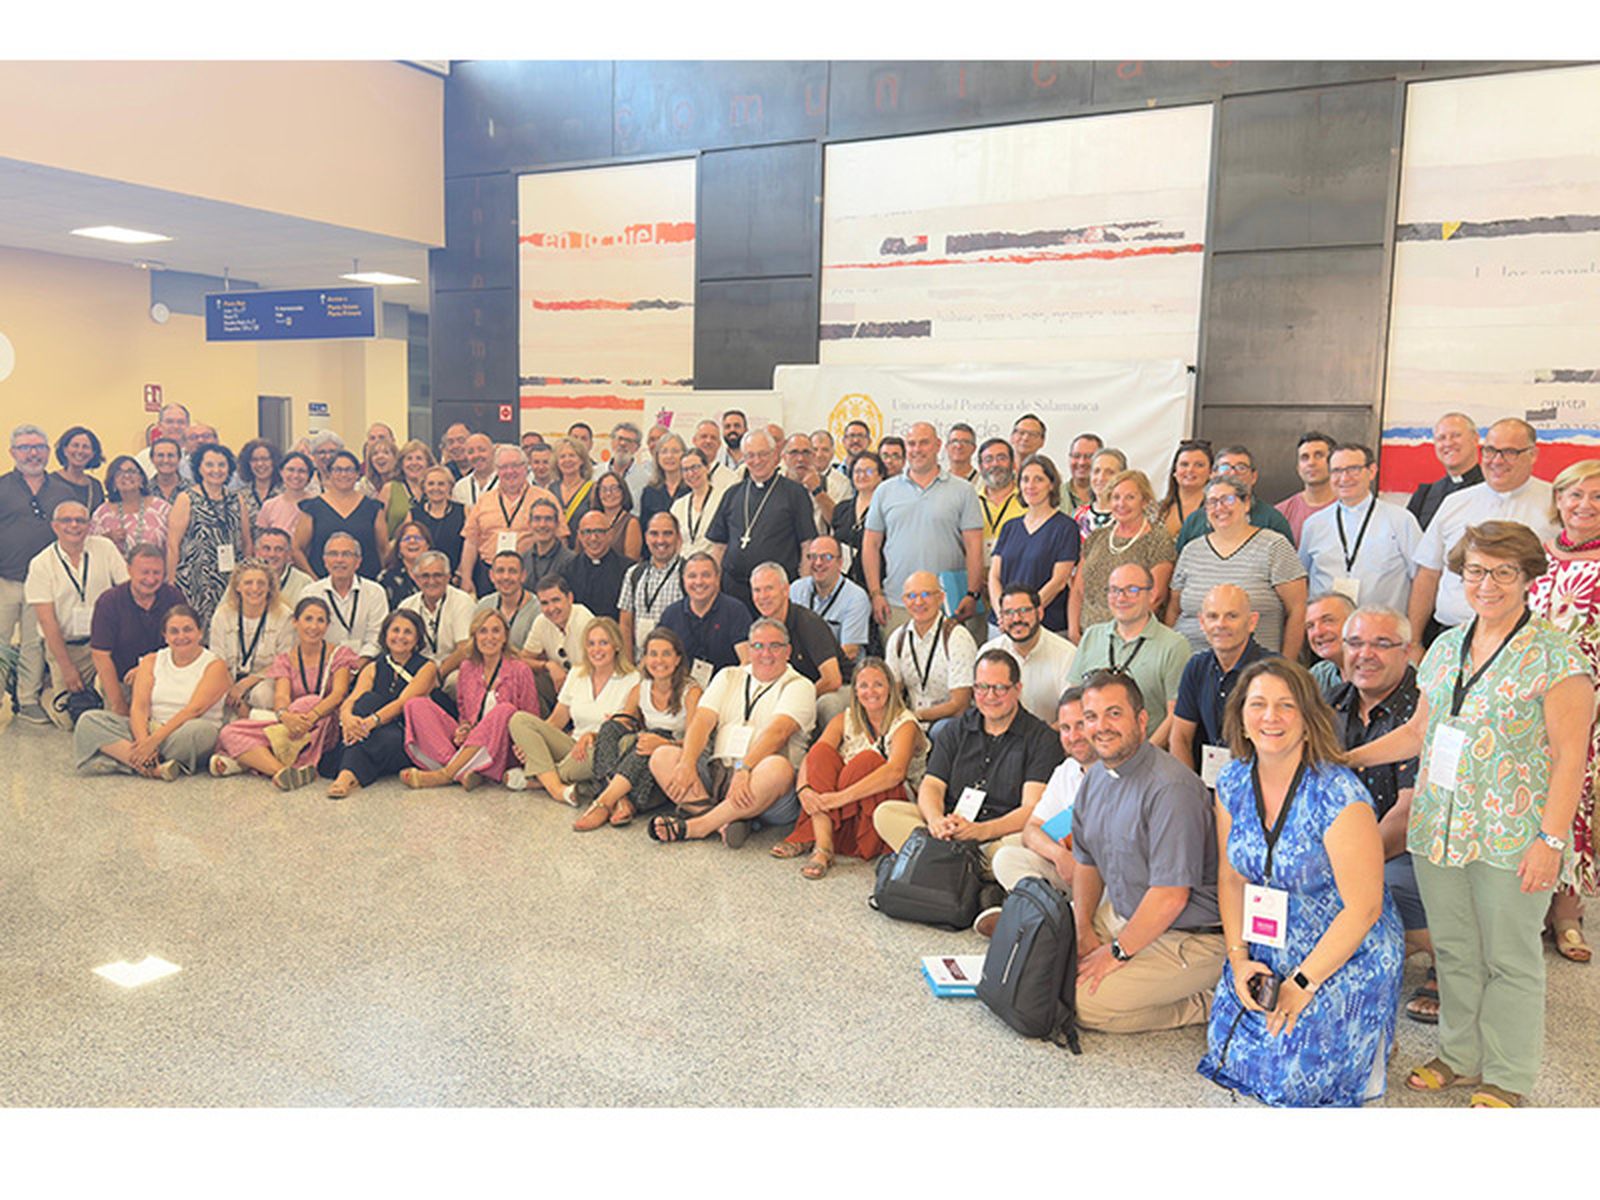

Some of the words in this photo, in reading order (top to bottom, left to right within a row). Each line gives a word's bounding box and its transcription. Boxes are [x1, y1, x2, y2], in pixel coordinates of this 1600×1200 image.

[891, 398, 958, 411] Universidad
[960, 398, 1014, 411] Pontificia
[1016, 399, 1030, 411] de
[1033, 399, 1099, 412] Salamanca
[975, 418, 1000, 438] de
